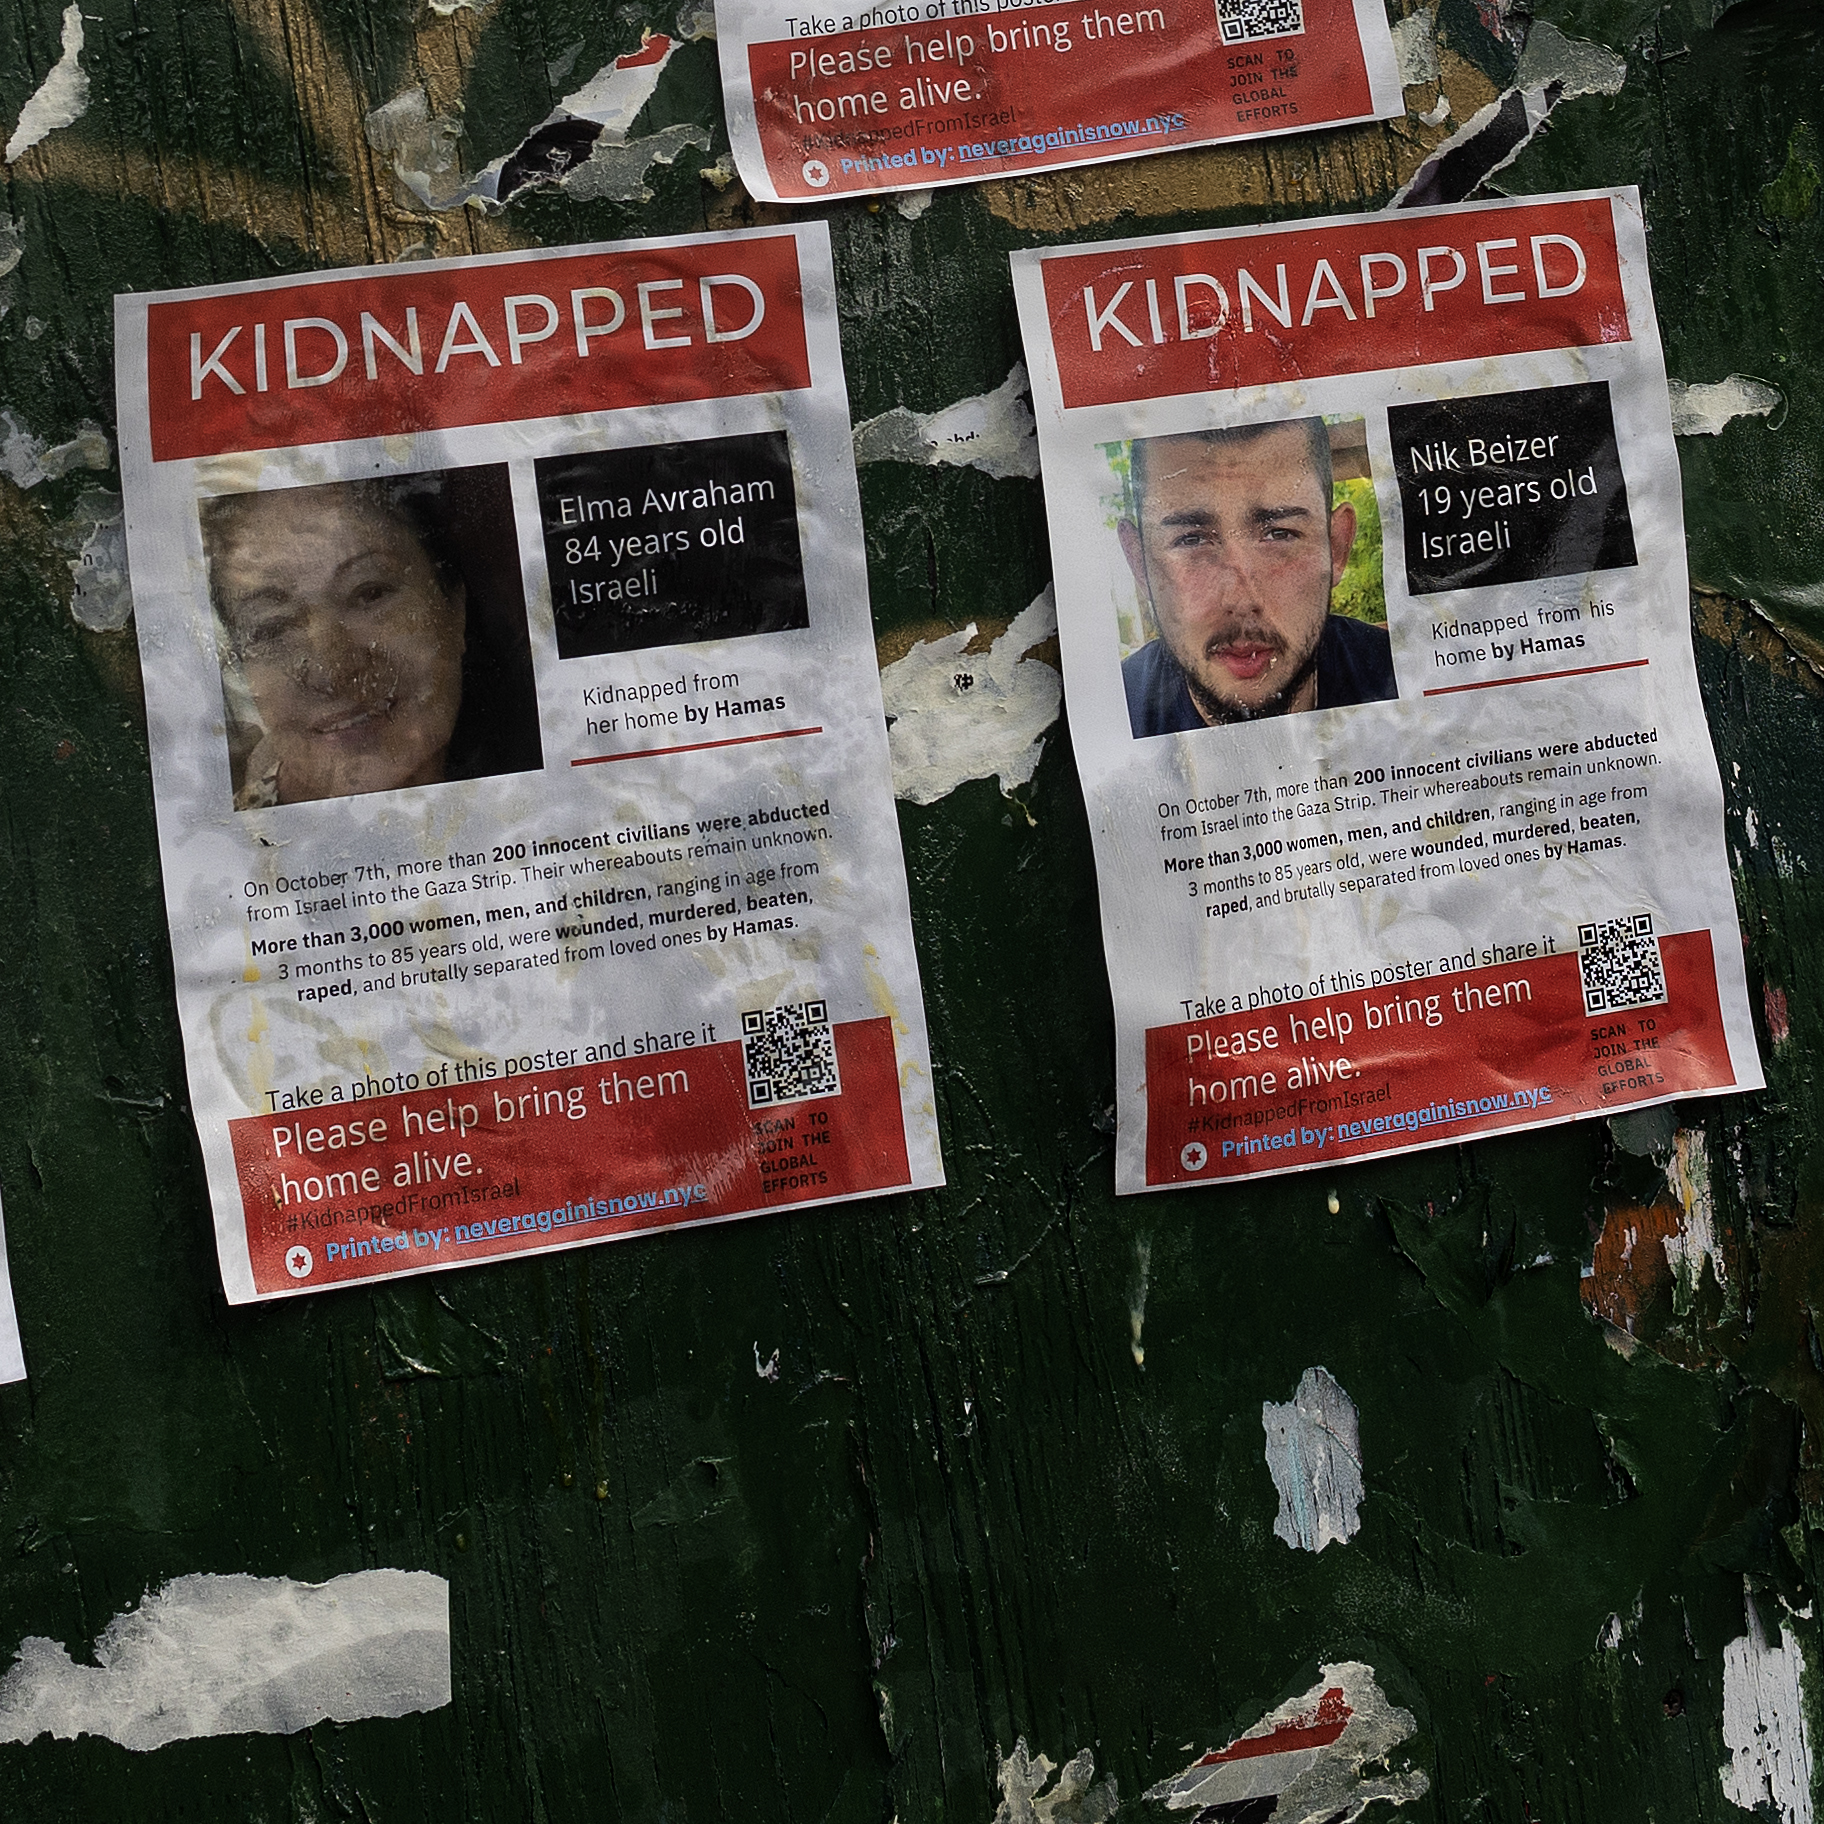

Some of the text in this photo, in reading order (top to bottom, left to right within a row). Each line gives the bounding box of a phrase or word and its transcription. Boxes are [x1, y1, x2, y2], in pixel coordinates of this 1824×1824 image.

[1084, 234, 1587, 351] KIDNAPPED
[189, 274, 764, 403] KIDNAPPED
[1410, 429, 1560, 474] Nik Beizer
[558, 475, 775, 524] Elma Avraham
[1416, 467, 1597, 517] 19 years old
[1421, 522, 1511, 558] Israeli
[568, 570, 659, 606] Israeli
[1156, 727, 1658, 820] On October 7th, more than 200 innocent civilians were abducted
